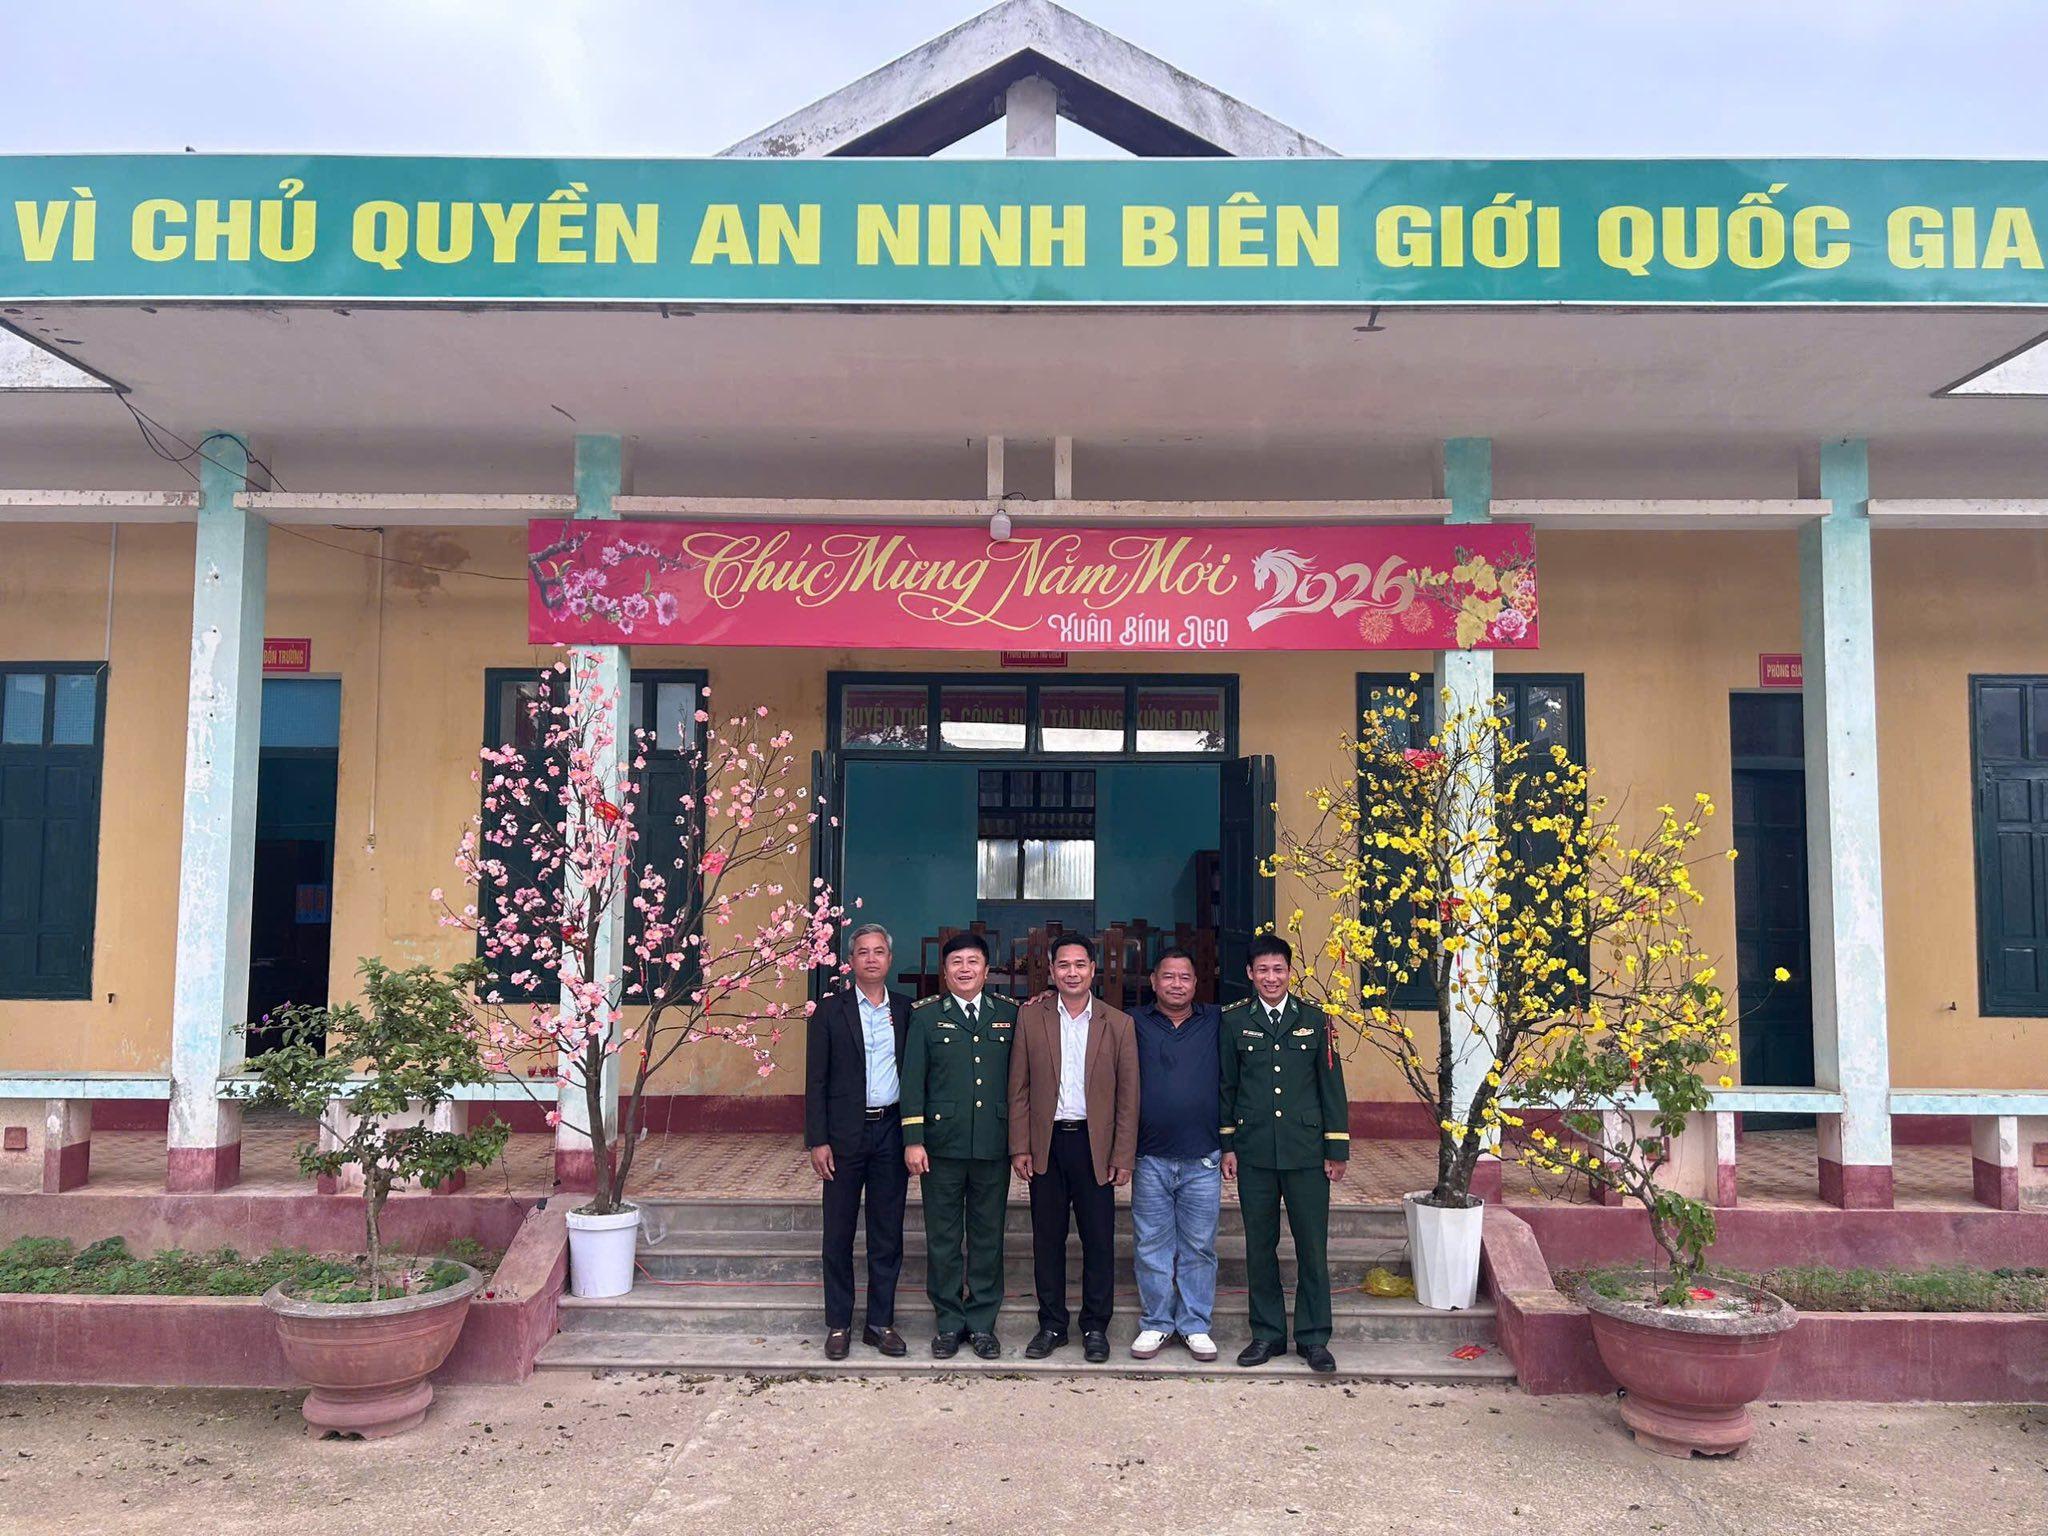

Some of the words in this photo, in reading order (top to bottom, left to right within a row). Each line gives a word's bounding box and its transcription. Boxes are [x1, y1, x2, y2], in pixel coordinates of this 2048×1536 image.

[16, 187, 96, 262] VÌ
[131, 179, 317, 263] CHỦ
[352, 182, 659, 270] QUYỀN
[691, 204, 821, 265] AN
[857, 204, 1086, 267] NINH
[1122, 192, 1339, 267] BIÊN
[1376, 192, 1561, 269] GIỚI
[1598, 184, 1851, 276] QUỐC
[1887, 206, 2045, 269] GIA
[682, 530, 836, 609] Chúc
[796, 534, 992, 628] Mừng
[972, 534, 1128, 630] Năm
[1083, 536, 1238, 609] Mới
[1246, 546, 1416, 632] 2026
